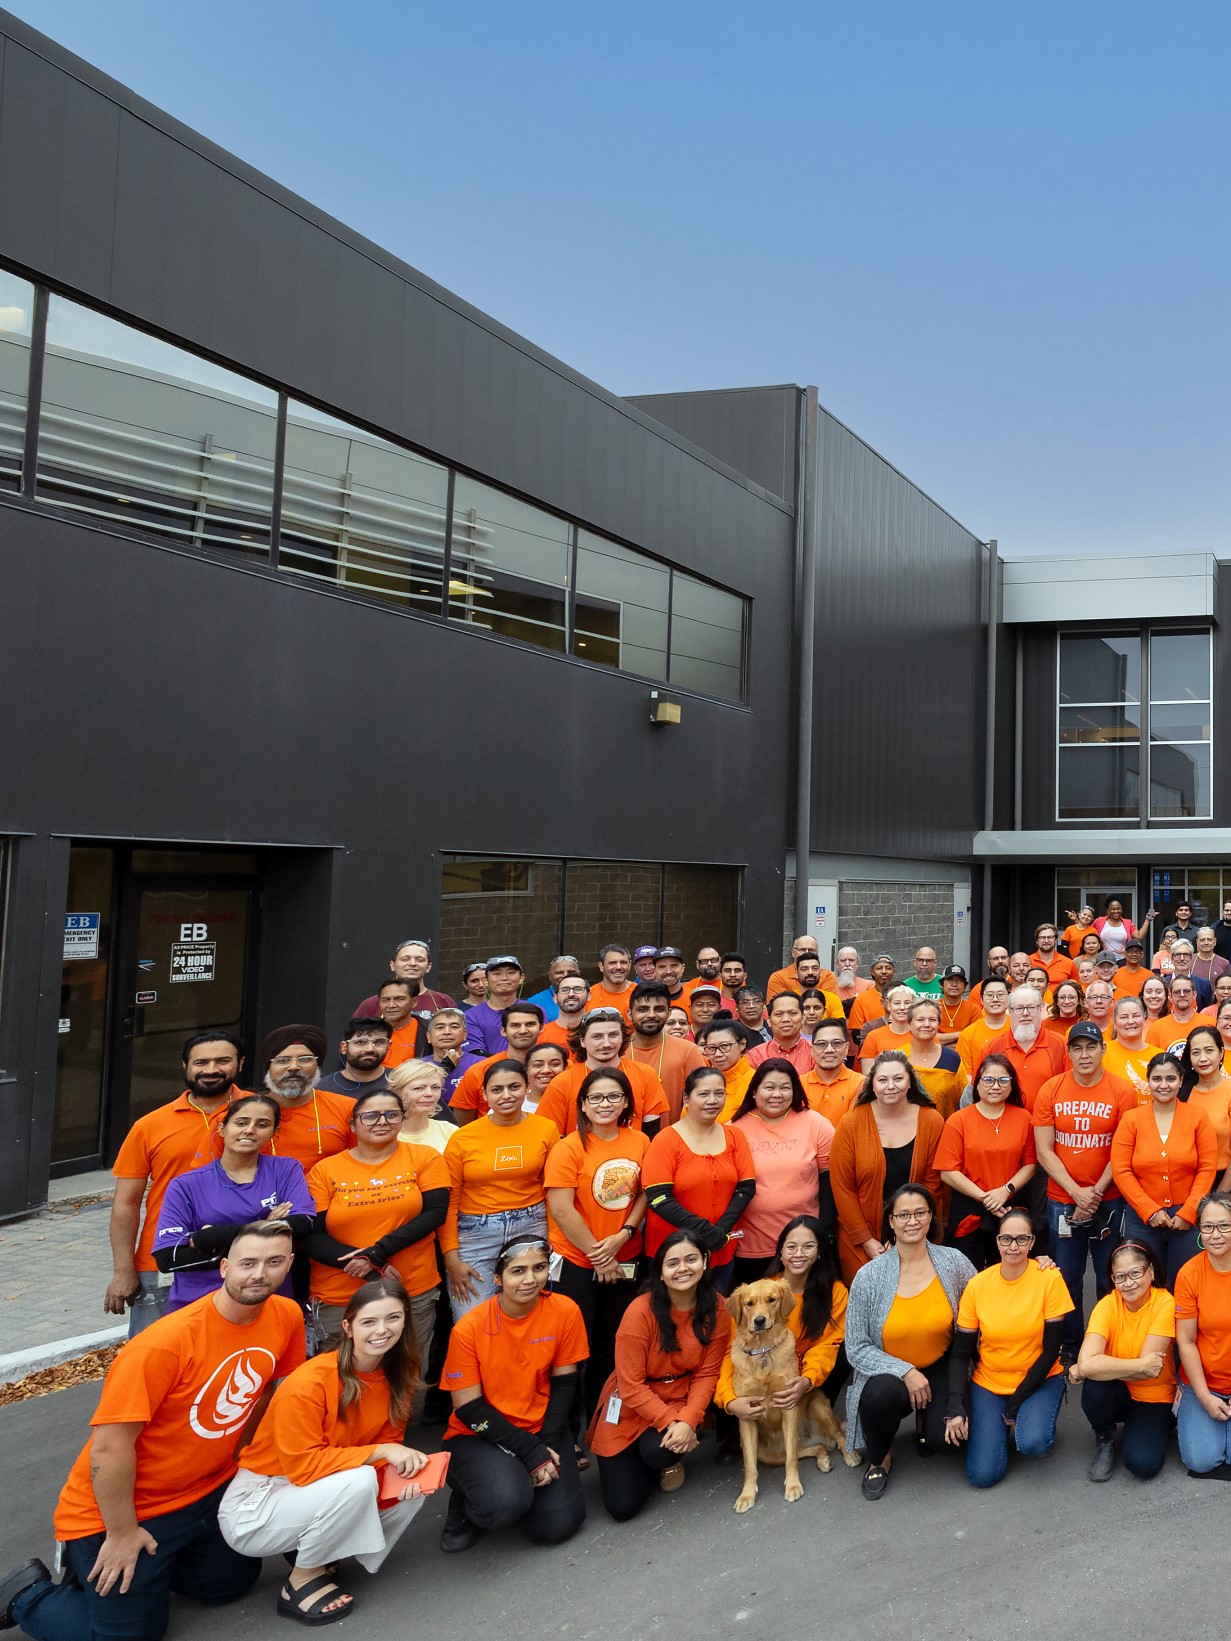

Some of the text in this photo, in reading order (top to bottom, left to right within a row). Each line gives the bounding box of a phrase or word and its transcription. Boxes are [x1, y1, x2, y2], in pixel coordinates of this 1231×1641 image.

[66, 916, 90, 928] EB
[180, 923, 208, 942] EB
[173, 955, 213, 967] 24 HOUR
[172, 972, 212, 981] SURVEILLANCE
[1054, 1100, 1113, 1119] PREPARE
[1074, 1116, 1090, 1131] TO
[348, 1194, 406, 1208] Extra fries?
[158, 1226, 184, 1238] price
